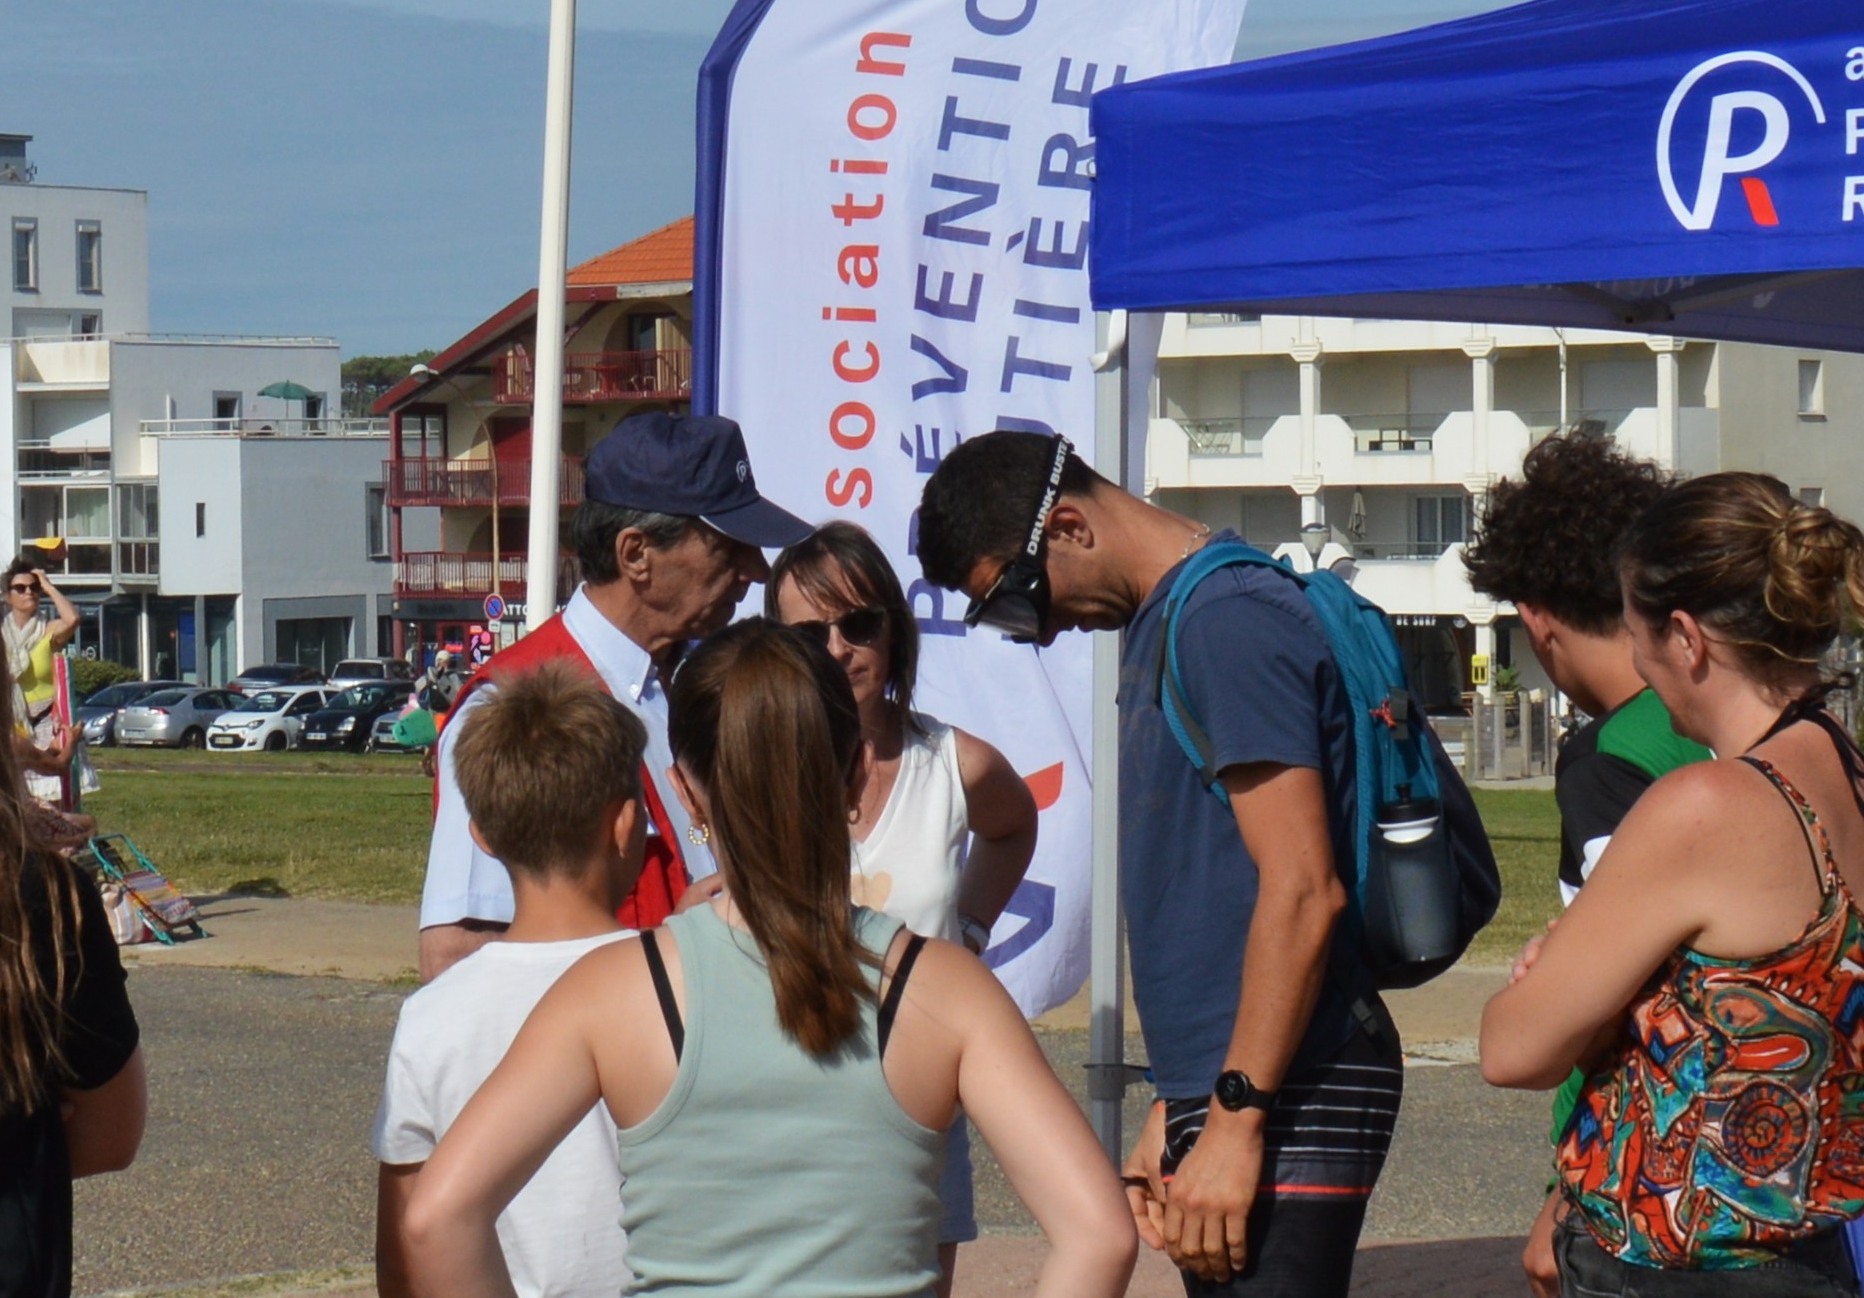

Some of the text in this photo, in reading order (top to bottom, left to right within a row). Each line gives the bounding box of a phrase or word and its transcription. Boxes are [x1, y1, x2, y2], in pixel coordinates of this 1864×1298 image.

[822, 31, 913, 509] sociation
[1027, 438, 1072, 555] DRUNK BUSTE
